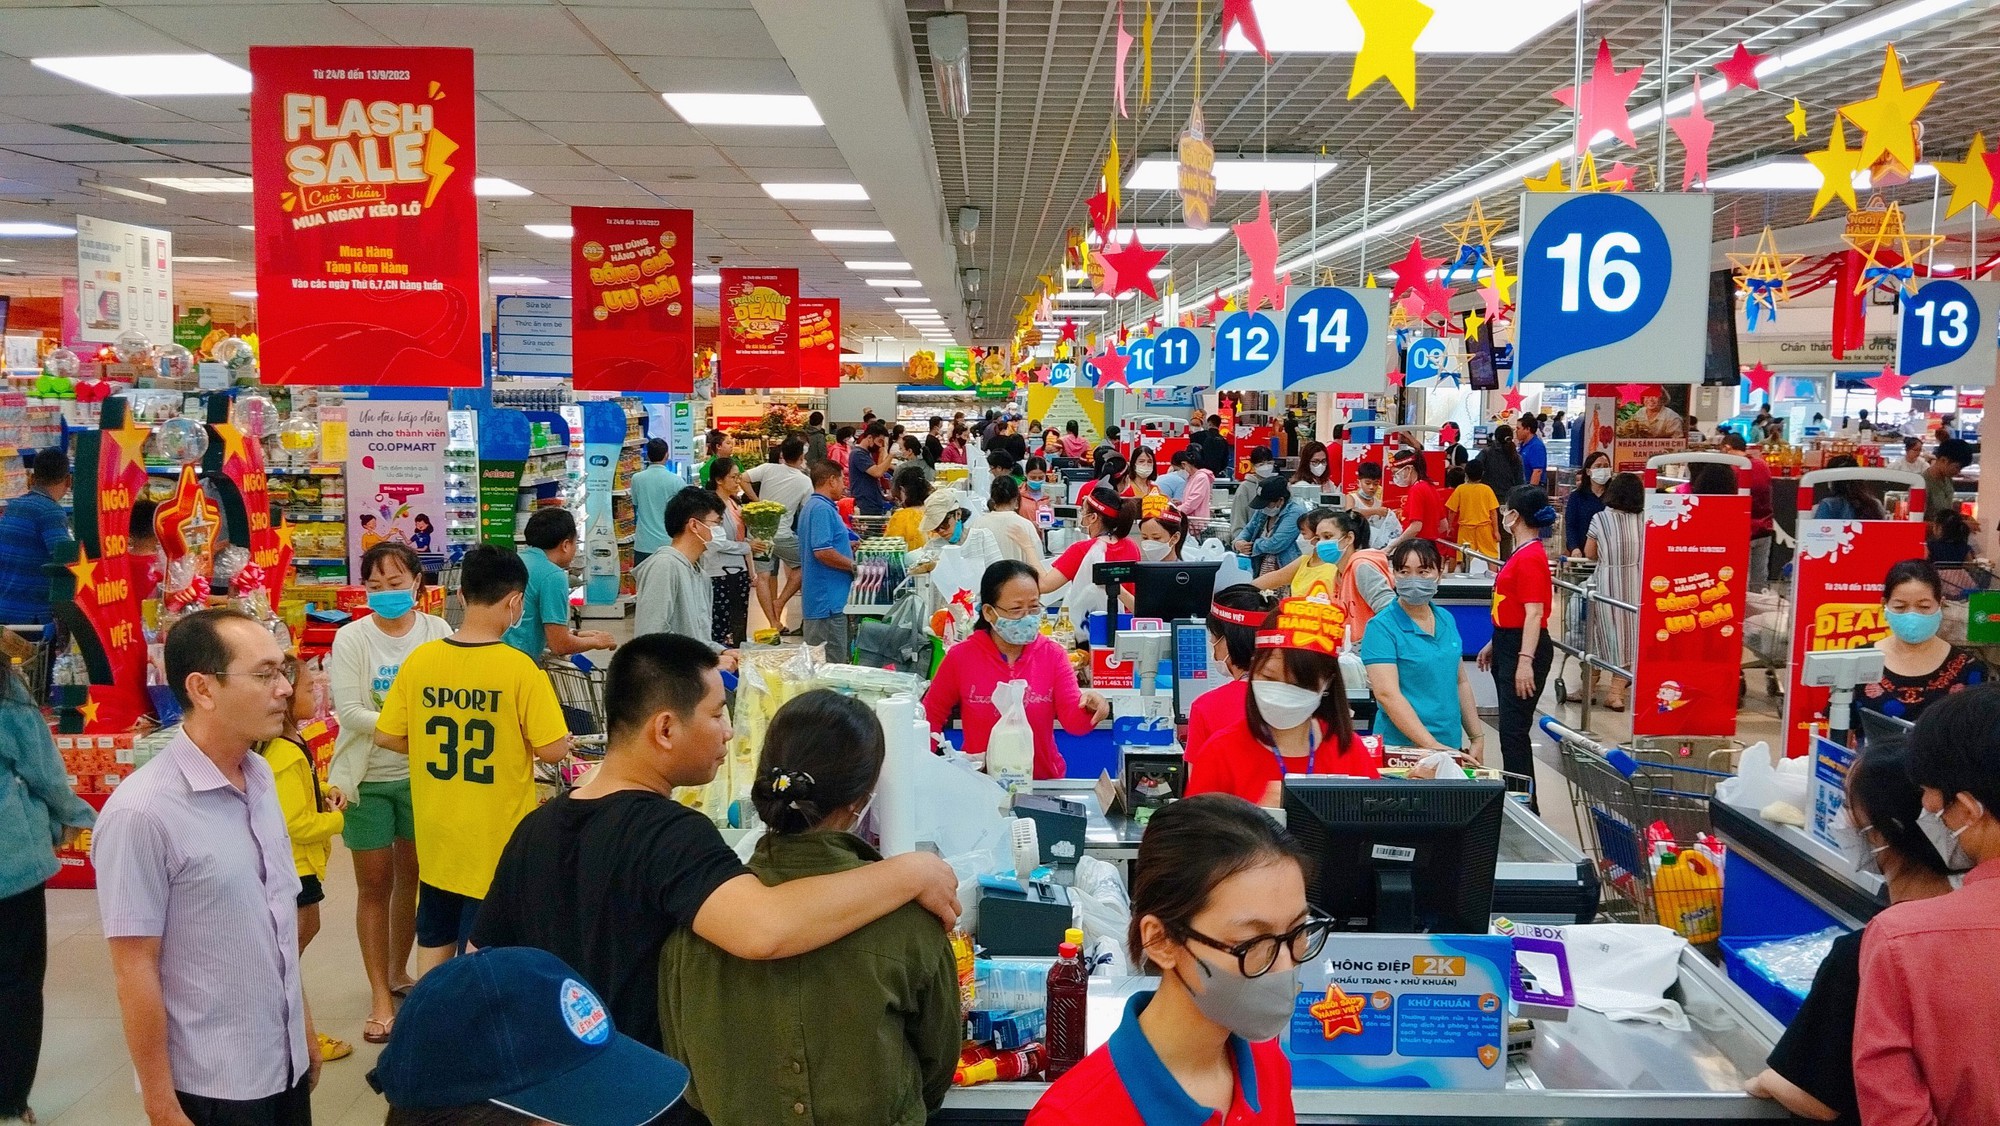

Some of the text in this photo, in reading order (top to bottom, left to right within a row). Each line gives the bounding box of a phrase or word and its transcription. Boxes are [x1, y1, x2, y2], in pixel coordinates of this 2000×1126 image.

[313, 68, 410, 80] Từ 24/8 đến 13/9/2023
[284, 93, 433, 142] FLASH
[286, 131, 429, 185] SALE
[308, 187, 341, 206] Cuối
[292, 214, 325, 230] MUA
[327, 206, 365, 223] NGAY
[340, 245, 393, 260] Mua Hàng
[611, 245, 656, 262] HÀNG VIỆT
[325, 260, 408, 276] Tặng Kèm Hàng
[590, 249, 675, 286] ĐỒNG GIÁ
[1546, 231, 1641, 312] 16
[292, 278, 310, 289] Vào
[313, 278, 327, 289] các
[329, 279, 349, 291] ngày
[352, 279, 367, 290] Thứ
[400, 279, 421, 291] hàng
[423, 279, 443, 291] tuần
[640, 274, 681, 307] ĐÃI
[734, 303, 786, 321] DEAL
[1914, 300, 1968, 347] 13
[1298, 308, 1350, 353] 14
[1160, 338, 1188, 365] 11
[1225, 326, 1270, 362] 12
[1413, 348, 1448, 369] 09
[1054, 368, 1071, 379] 04
[349, 428, 446, 437] dành cho thành viên
[368, 442, 437, 452] CO.OPMART
[242, 468, 267, 492] NGÔI
[101, 483, 130, 512] NGÔI
[251, 512, 268, 531] SAO
[105, 534, 127, 559] SAO
[254, 545, 279, 569] HÀNG
[97, 576, 128, 605] HÀNG
[1233, 612, 1245, 623] VIỆT
[1283, 600, 1345, 624] NGÔI SAO
[1815, 608, 1890, 637] DEAL
[109, 619, 134, 651] VIỆT
[1277, 616, 1346, 640] HÀNG VIỆT
[422, 686, 503, 713] SPORT
[425, 715, 495, 784] 32
[1516, 925, 1564, 940] URBOX
[1328, 957, 1456, 975] HÔNG ĐIỆP 2K
[1361, 977, 1391, 985] TRANG
[1319, 1004, 1360, 1019] HÀNG VIỆT
[1320, 997, 1357, 1010] NGÔI SAO
[1408, 997, 1432, 1007] KHỬ
